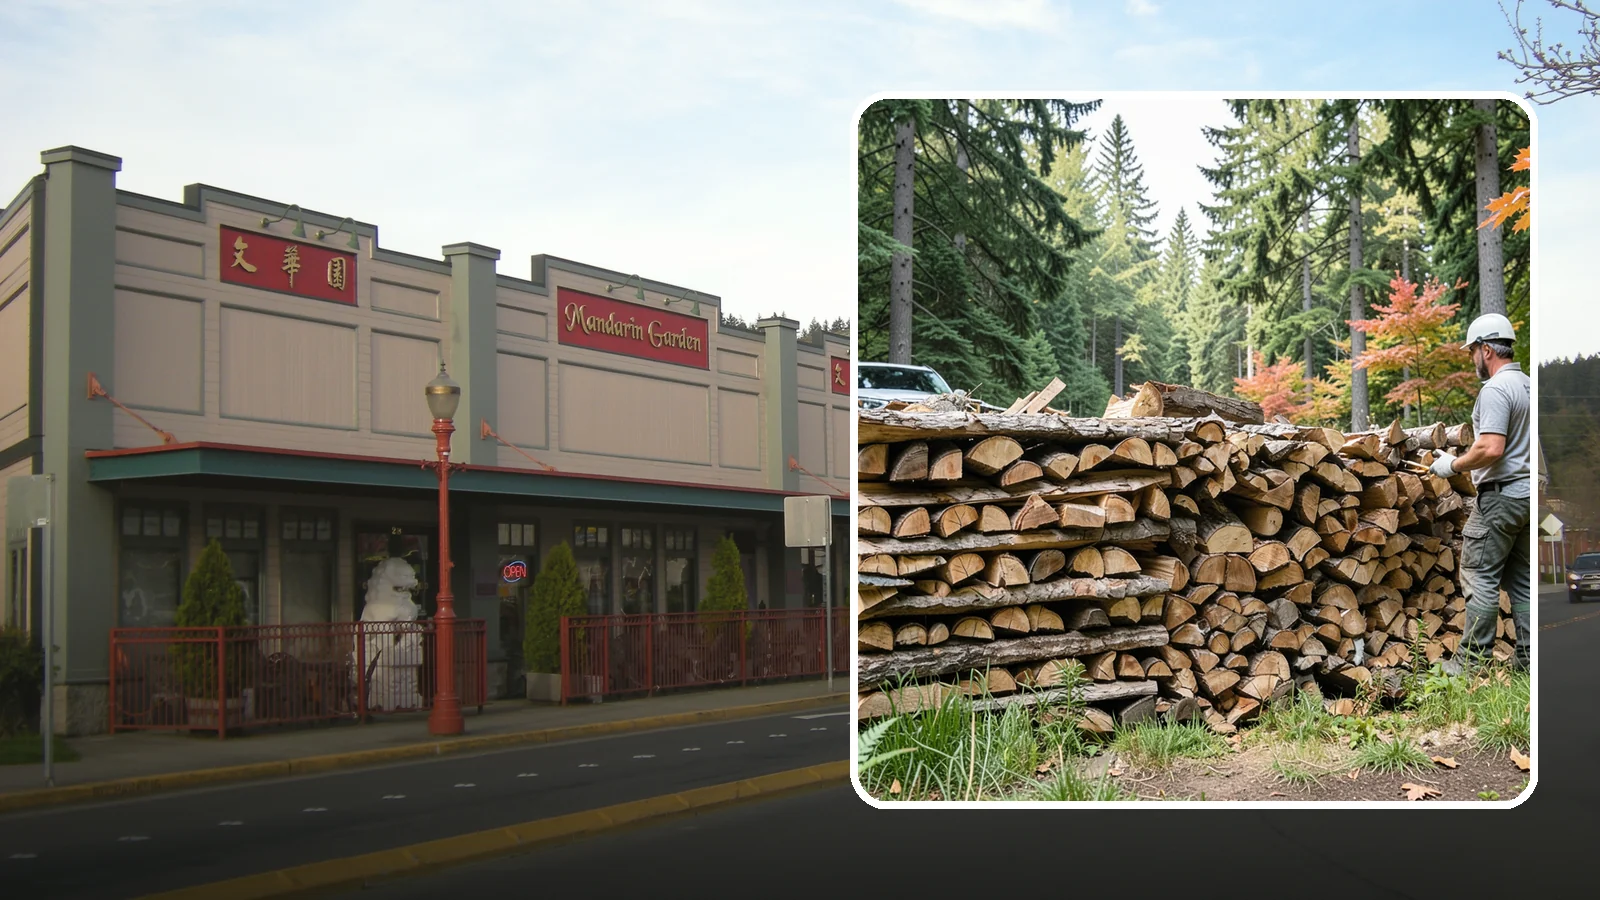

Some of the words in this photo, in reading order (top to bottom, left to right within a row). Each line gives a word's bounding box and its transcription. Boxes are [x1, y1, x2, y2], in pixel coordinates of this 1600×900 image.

[230, 235, 346, 291] 文華園
[564, 302, 644, 341] Mandarin
[648, 320, 701, 352] Garden
[503, 565, 527, 578] OPEN
